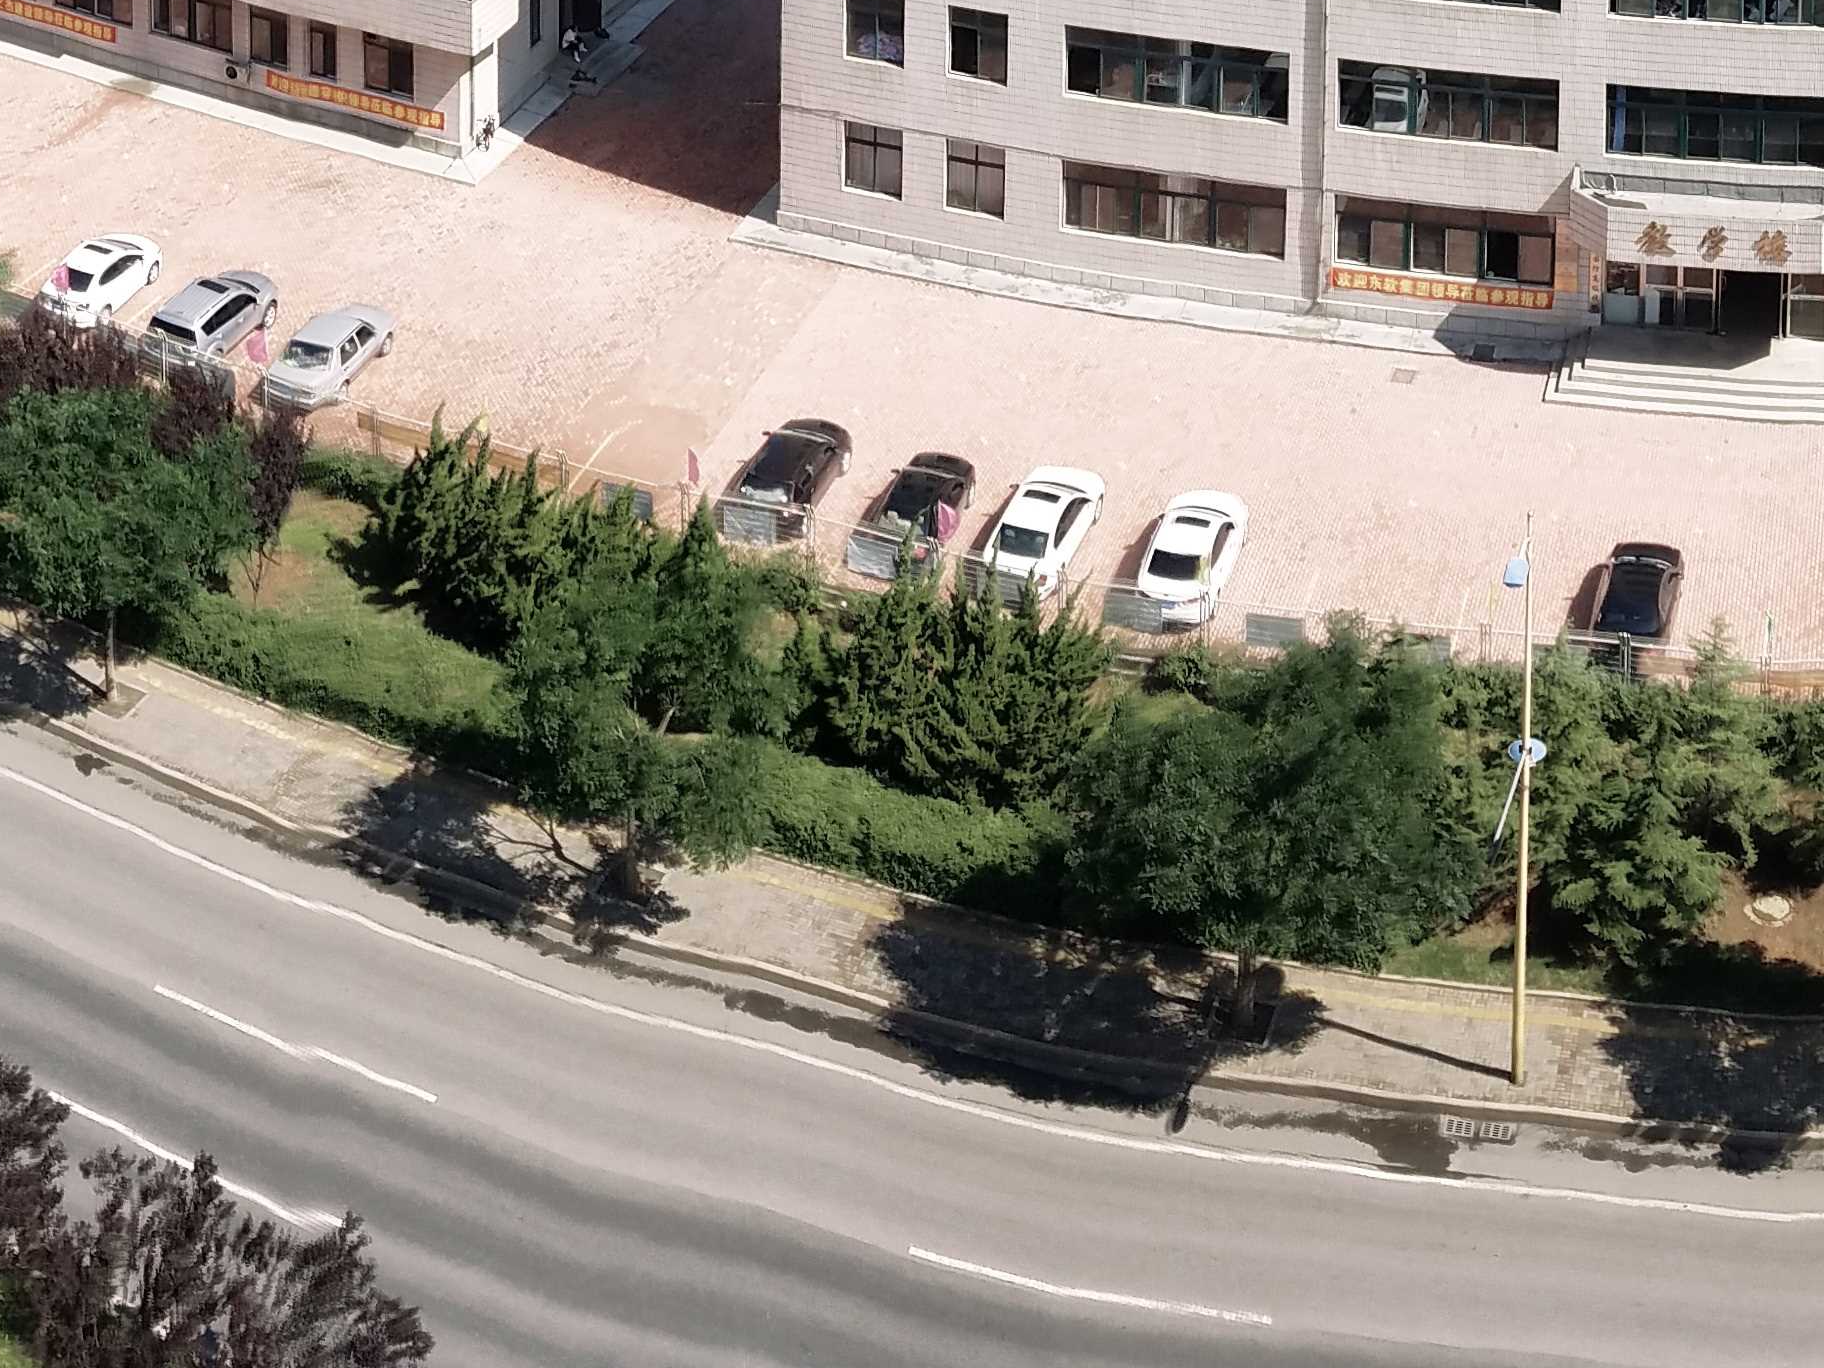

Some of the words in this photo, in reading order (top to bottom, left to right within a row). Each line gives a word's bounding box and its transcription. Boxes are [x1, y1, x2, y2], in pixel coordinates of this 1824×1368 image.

[1633, 220, 1793, 267] 教学楼
[1334, 272, 1550, 308] 欢迎东软集团领导莅临参观指导
